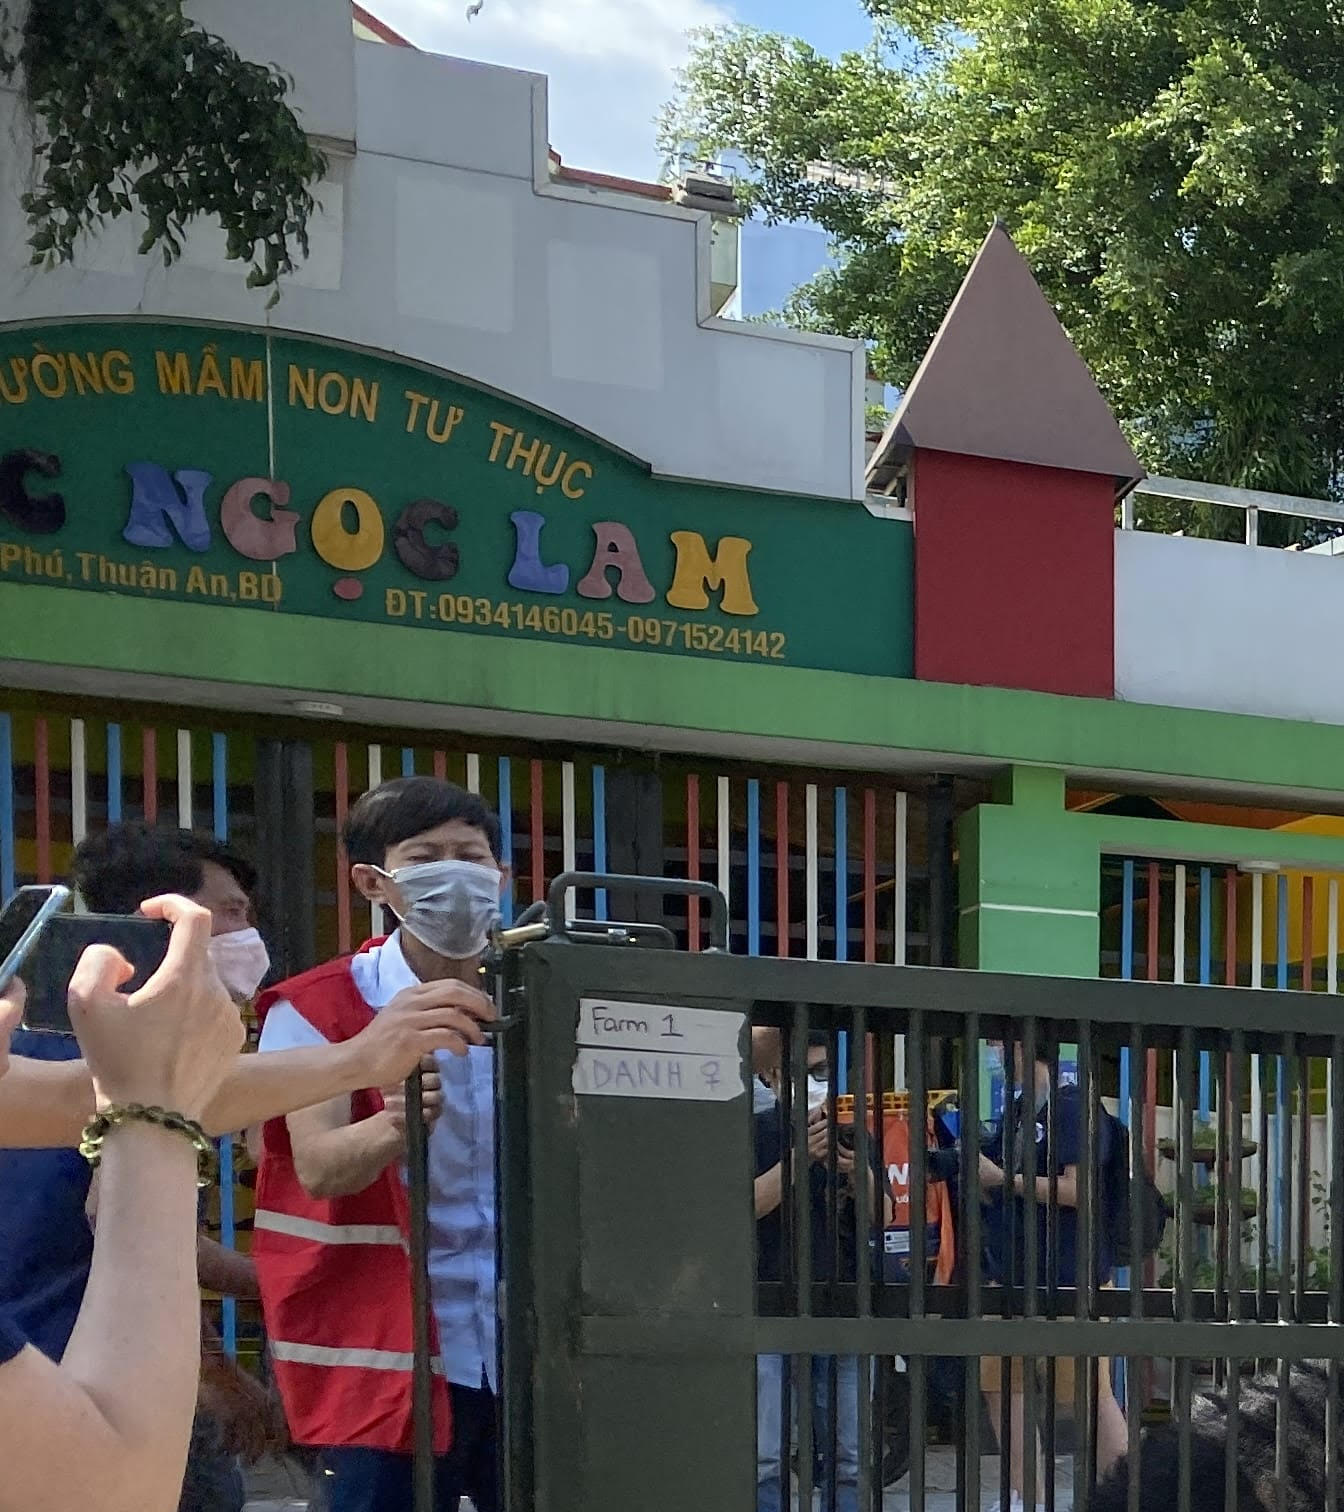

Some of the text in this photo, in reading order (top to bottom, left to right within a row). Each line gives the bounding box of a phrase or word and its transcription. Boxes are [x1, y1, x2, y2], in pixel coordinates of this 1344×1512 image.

[0, 341, 592, 499] ƯỜNG MẦM NON TƯ THỤC
[0, 448, 759, 616] C NGỌC LAM
[76, 552, 177, 594] Thuận
[591, 1006, 684, 1037] Farm 1
[593, 1058, 683, 1089] DANH
